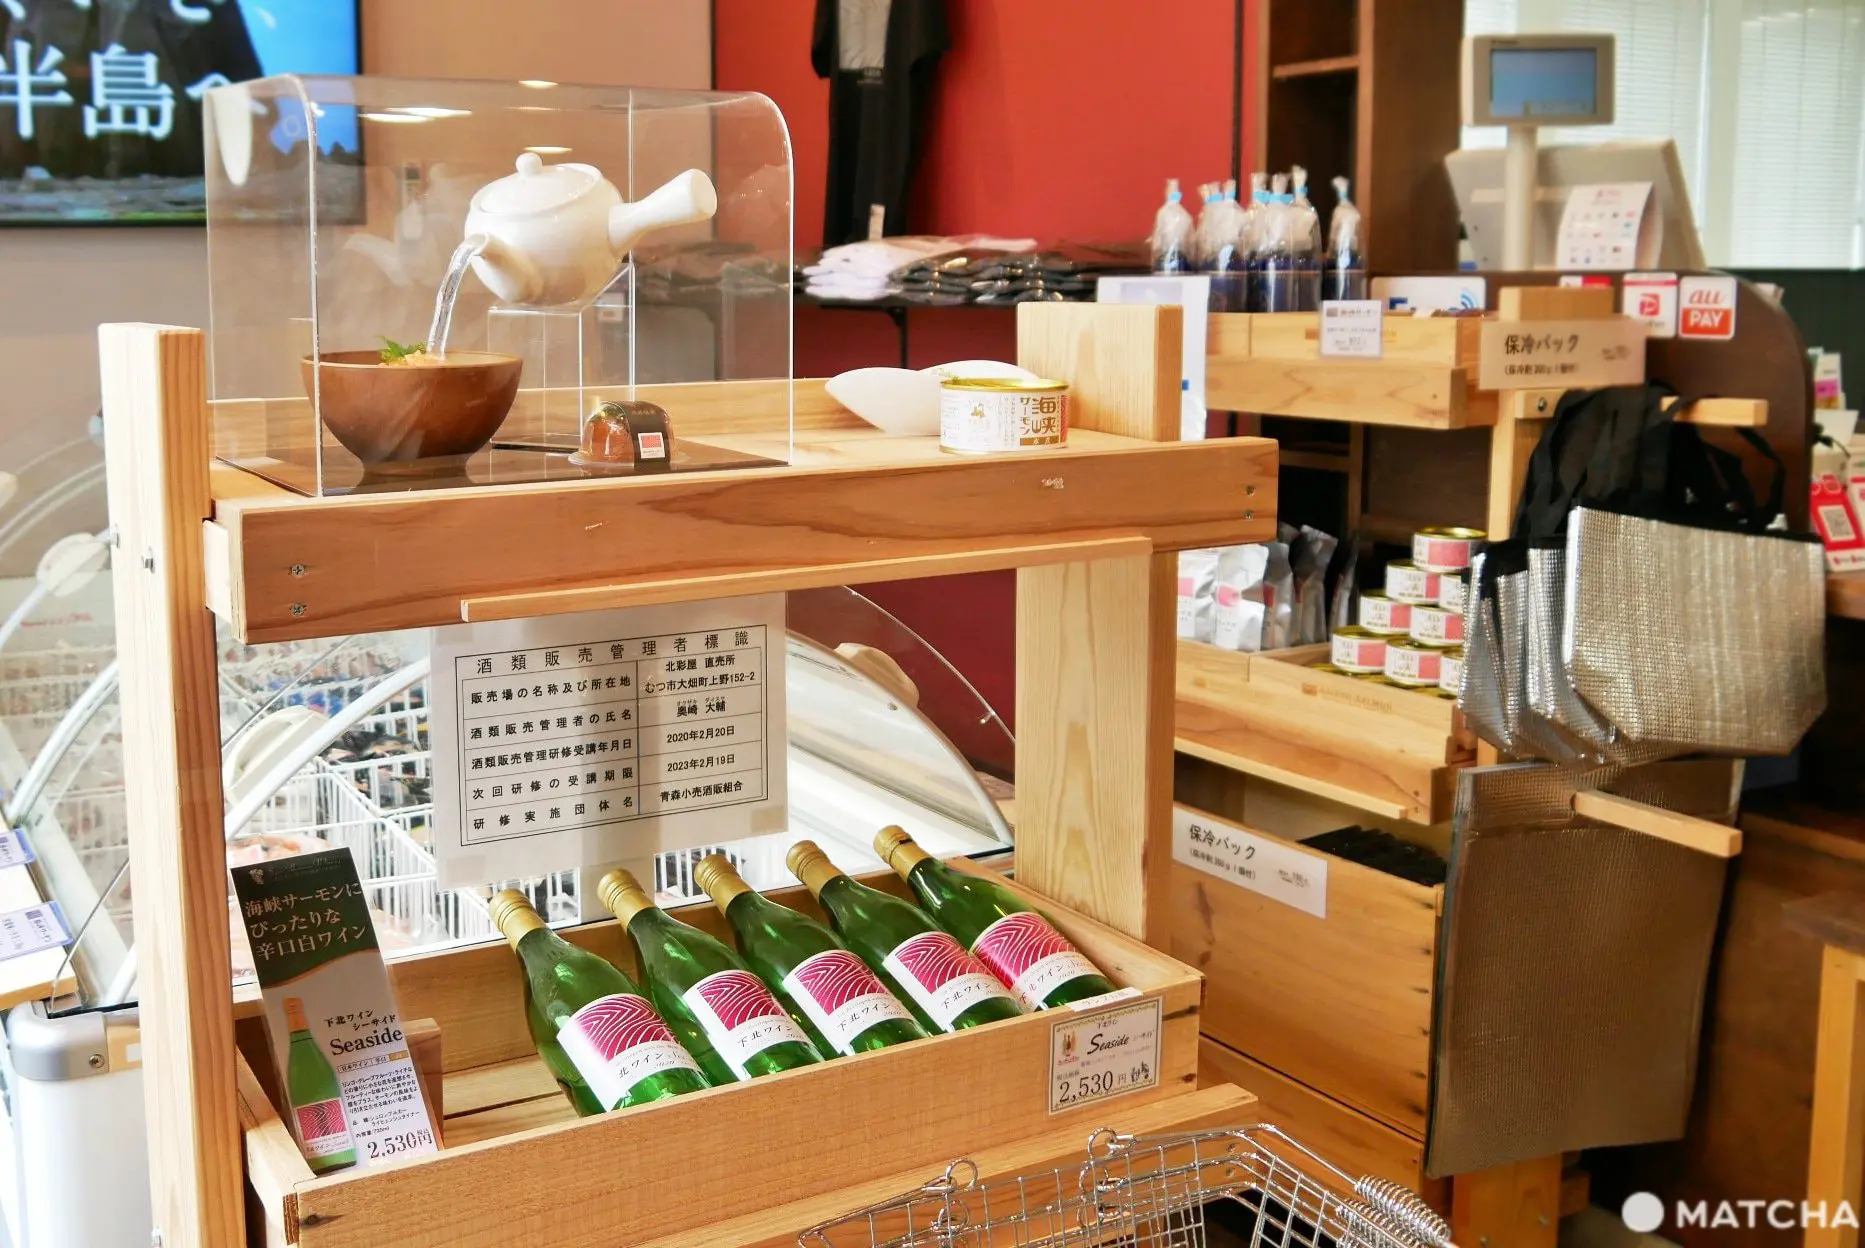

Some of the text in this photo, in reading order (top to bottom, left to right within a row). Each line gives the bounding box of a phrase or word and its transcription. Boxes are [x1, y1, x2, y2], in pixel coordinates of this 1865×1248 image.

[1689, 309, 1724, 328] PAY
[1019, 397, 1031, 436] サーモン
[1031, 397, 1057, 434] 海峡
[476, 630, 750, 675] 酒類販売管理者標識
[665, 653, 736, 673] 北彩屋 直売所
[470, 675, 632, 705] 販売場の名称及び所在地
[644, 670, 756, 695] むつ市大畑町上野152-2
[705, 699, 727, 714] 大輔
[469, 708, 633, 741] 酒類販売管理者の氏名
[666, 725, 736, 744] 2020年2月20日
[470, 738, 633, 771] 酒類販売管理研修受講年月日
[666, 753, 736, 773] 2023年2月19日
[471, 766, 634, 801] 次回研修の受講期限
[659, 780, 744, 803] 青森小売酒販組合
[472, 795, 634, 831] 研修実施団体名
[244, 880, 363, 919] 海峡サーモンに
[249, 907, 342, 940] ぴったりな
[255, 922, 367, 962] 辛口白ワイン
[941, 982, 992, 1010] 下北ワイン
[323, 1008, 375, 1028] 下北ワイン
[351, 1012, 397, 1032] シーサイド
[837, 1002, 891, 1032] 下北ワイン
[329, 1026, 404, 1057] Seaside
[737, 1025, 794, 1048] 下北ワイン
[1087, 1033, 1130, 1055] Seaside
[1059, 1070, 1114, 1103] 2,530
